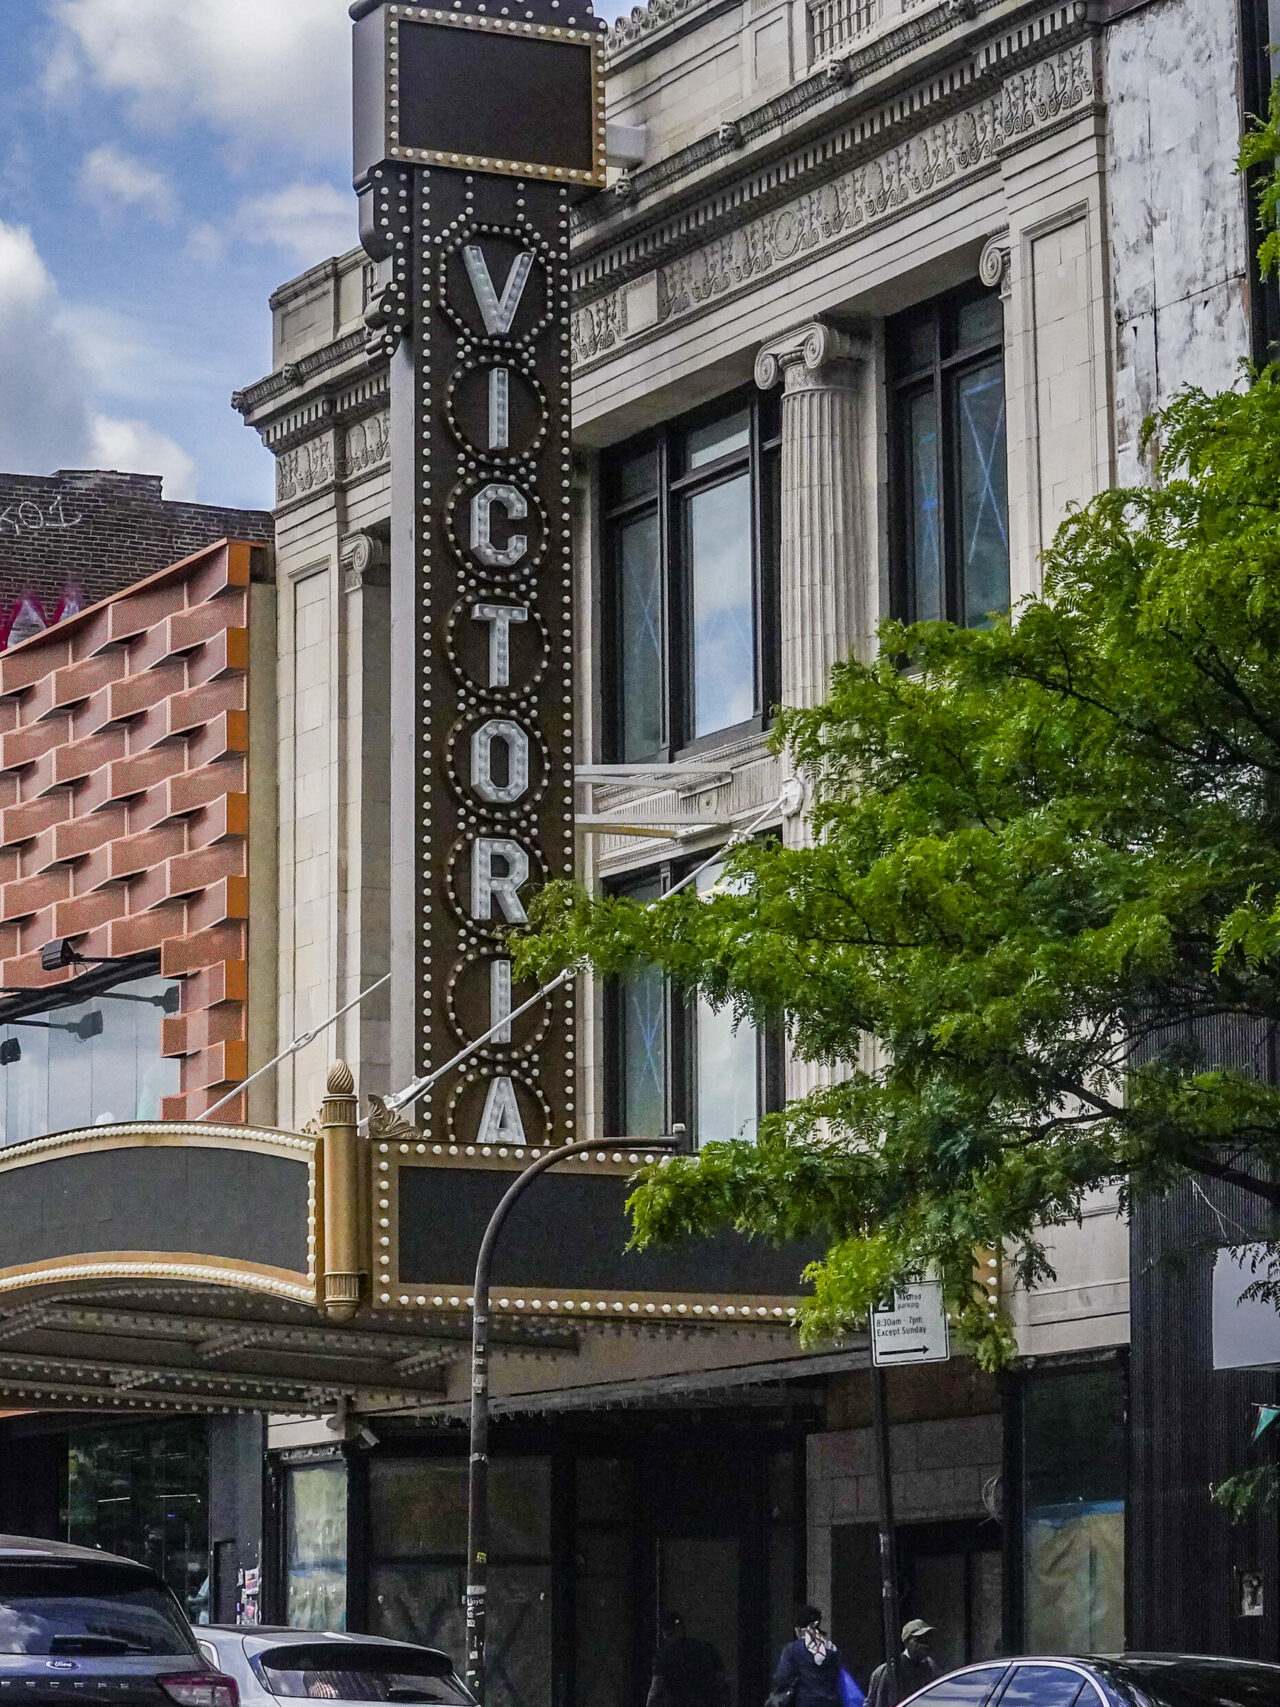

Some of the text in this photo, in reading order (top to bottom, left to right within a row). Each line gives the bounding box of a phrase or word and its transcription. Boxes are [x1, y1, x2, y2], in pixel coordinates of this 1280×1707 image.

[462, 245, 536, 1144] VICTORIA
[876, 1318, 902, 1328] 8:30am
[909, 1315, 923, 1325] 7pm
[876, 1325, 927, 1338] Except Sunday
